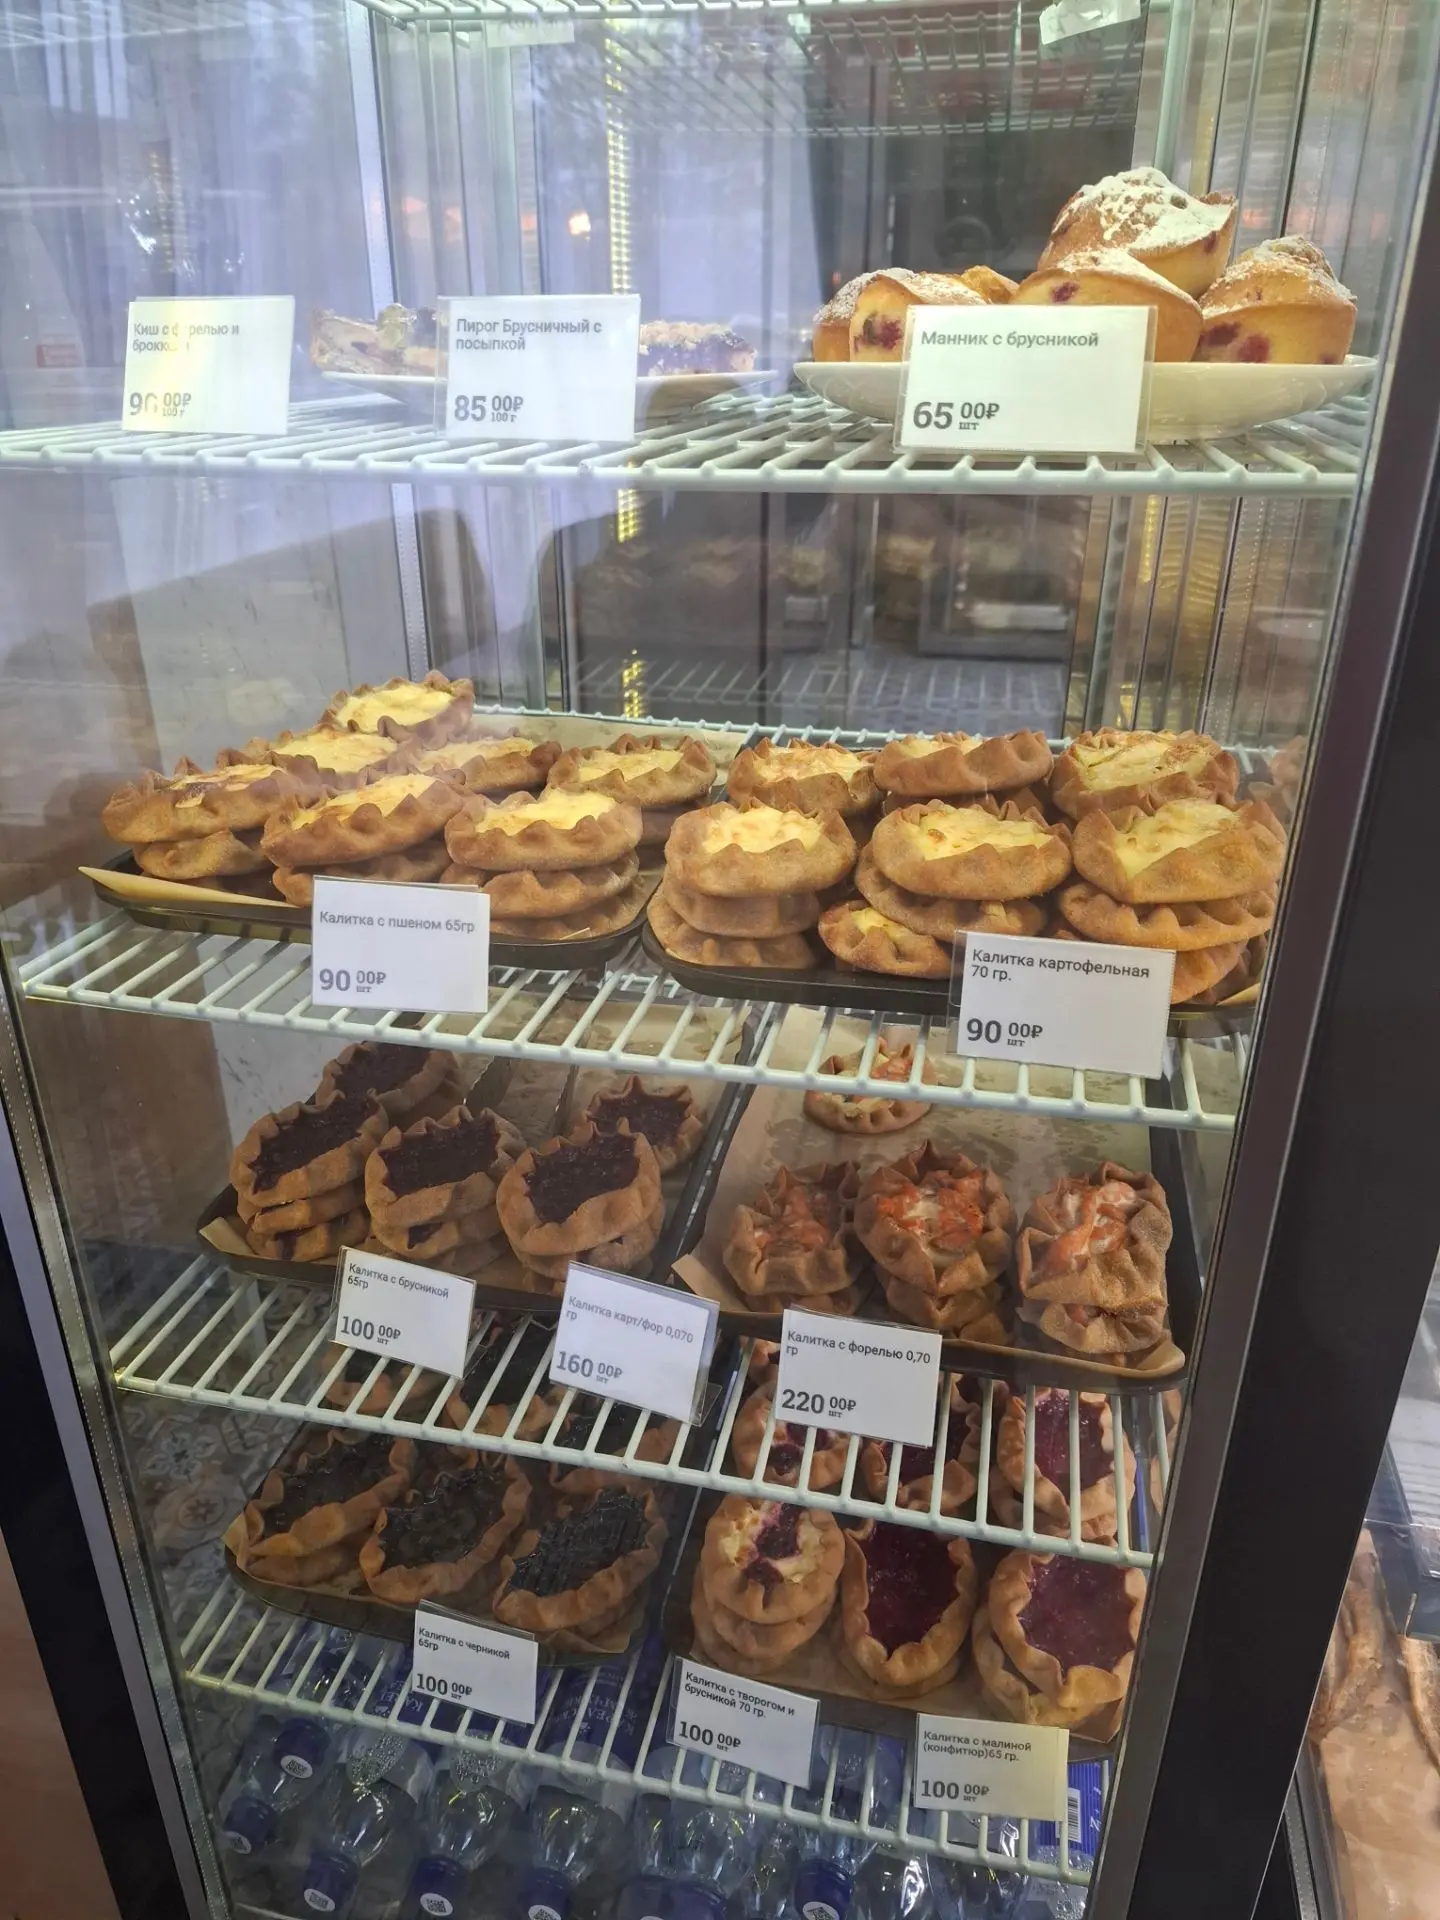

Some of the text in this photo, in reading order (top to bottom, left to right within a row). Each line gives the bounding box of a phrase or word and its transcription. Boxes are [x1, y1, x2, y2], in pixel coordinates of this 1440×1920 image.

[133, 323, 240, 338] Киш с фрелью и
[456, 318, 602, 336] Пирог Брусничный с
[456, 337, 526, 350] посыпкой
[921, 331, 1099, 348] Манник с брусникой
[454, 395, 487, 421] 85
[491, 412, 508, 423] 100
[913, 401, 1000, 430] 65 00₽
[959, 421, 979, 430] шт
[320, 911, 475, 934] Калитка с пшеном 65гр
[971, 964, 1012, 982] 70 гр.
[972, 949, 1150, 979] Калитка картофельная
[319, 968, 387, 992] 90 00₽
[356, 985, 372, 993] шт
[966, 1018, 1043, 1044] 90 00₽
[1006, 1038, 1026, 1047] шт
[347, 1275, 369, 1290] 65гр
[349, 1263, 388, 1282] Калитка
[398, 1276, 449, 1299] брусникой
[566, 1310, 577, 1321] гр
[568, 1295, 693, 1343] Калитка карт/фор 0,070
[340, 1316, 401, 1340] 100 00₽
[376, 1337, 389, 1345] шт
[786, 1345, 798, 1356] гр
[787, 1330, 931, 1364] Калитка с форелью 0,70
[556, 1351, 593, 1378] 160
[782, 1389, 856, 1414] 220 00₽
[828, 1409, 843, 1418] шт
[418, 1638, 439, 1651] 65гр
[419, 1627, 456, 1645] Калитка
[465, 1642, 510, 1659] черникой
[416, 1673, 448, 1695] 100
[686, 1671, 727, 1693] Калитка
[737, 1690, 785, 1713] творогом
[788, 1707, 795, 1716] и
[684, 1683, 736, 1708] брусникой
[739, 1701, 751, 1713] 70
[679, 1721, 741, 1748] 100 00₽
[923, 1730, 1032, 1752] Калитка с малиной
[716, 1744, 729, 1752] шт
[1004, 1750, 1020, 1762] гр.
[921, 1779, 990, 1800] 100 00₽
[963, 1794, 978, 1802] шт
